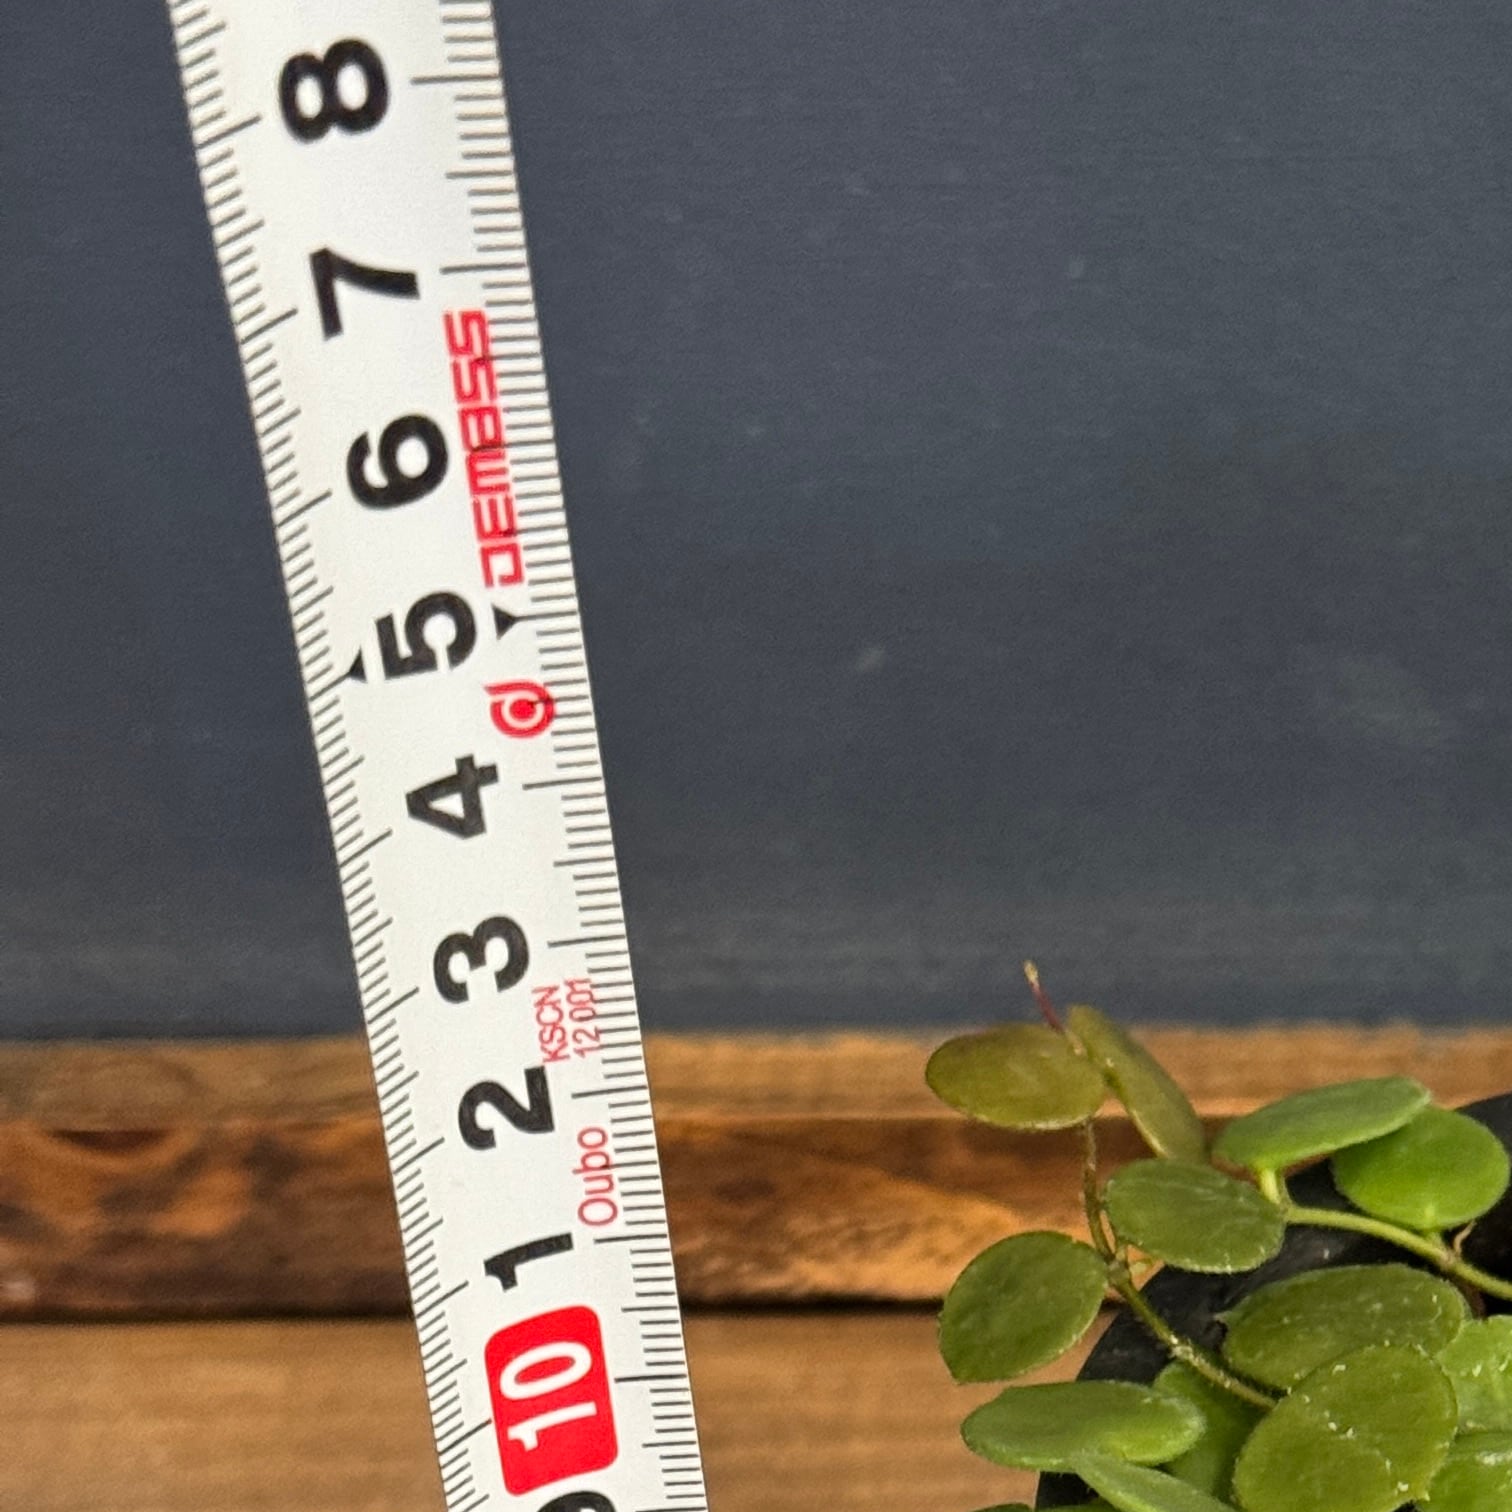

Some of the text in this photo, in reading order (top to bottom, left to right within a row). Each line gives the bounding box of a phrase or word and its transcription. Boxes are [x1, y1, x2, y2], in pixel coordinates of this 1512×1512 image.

[278, 38, 389, 143] 8
[309, 247, 420, 340] 7
[346, 412, 450, 511] 6
[374, 590, 477, 680] 5
[405, 754, 499, 840] 4
[432, 914, 530, 1005] 3
[531, 985, 571, 1063] KSCN
[457, 1064, 555, 1151] 2
[483, 1231, 574, 1293] 1
[499, 1340, 598, 1453] 10
